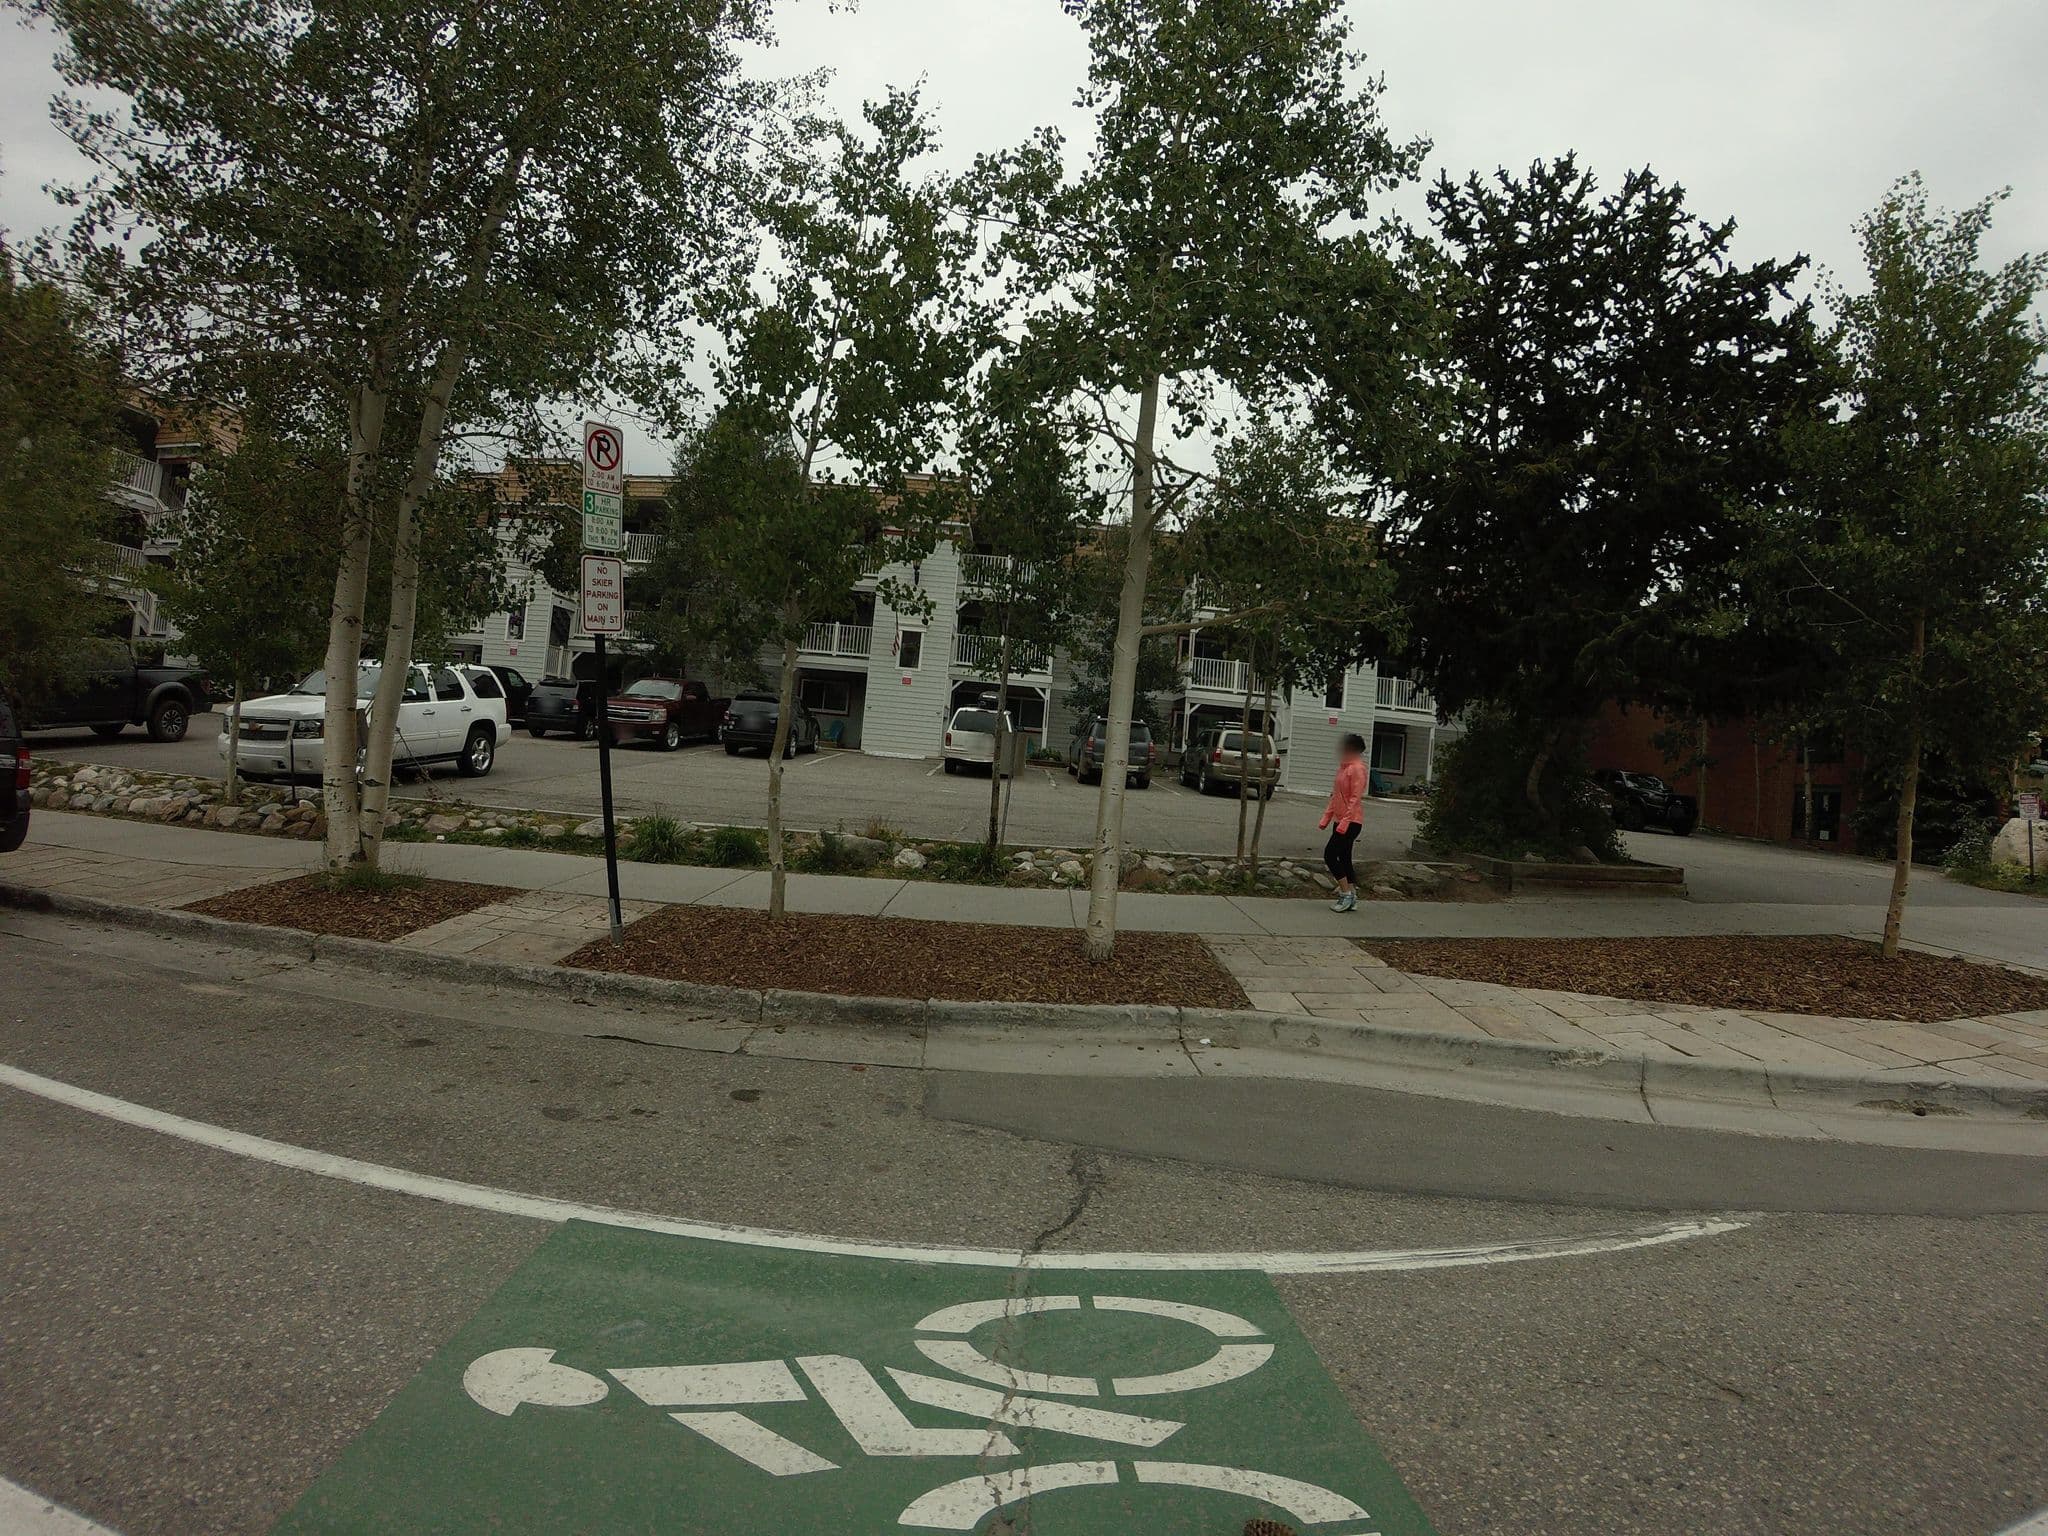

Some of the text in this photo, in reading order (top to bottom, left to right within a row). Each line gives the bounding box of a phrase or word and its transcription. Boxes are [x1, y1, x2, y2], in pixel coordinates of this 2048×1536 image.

[592, 470, 605, 479] 2:00
[586, 494, 594, 512] 3
[595, 505, 619, 516] PARKING
[597, 567, 608, 575] NO
[592, 579, 613, 587] SKIER
[586, 590, 619, 600] PARKING
[597, 603, 608, 611] ON
[587, 615, 619, 624] MAIN ST
